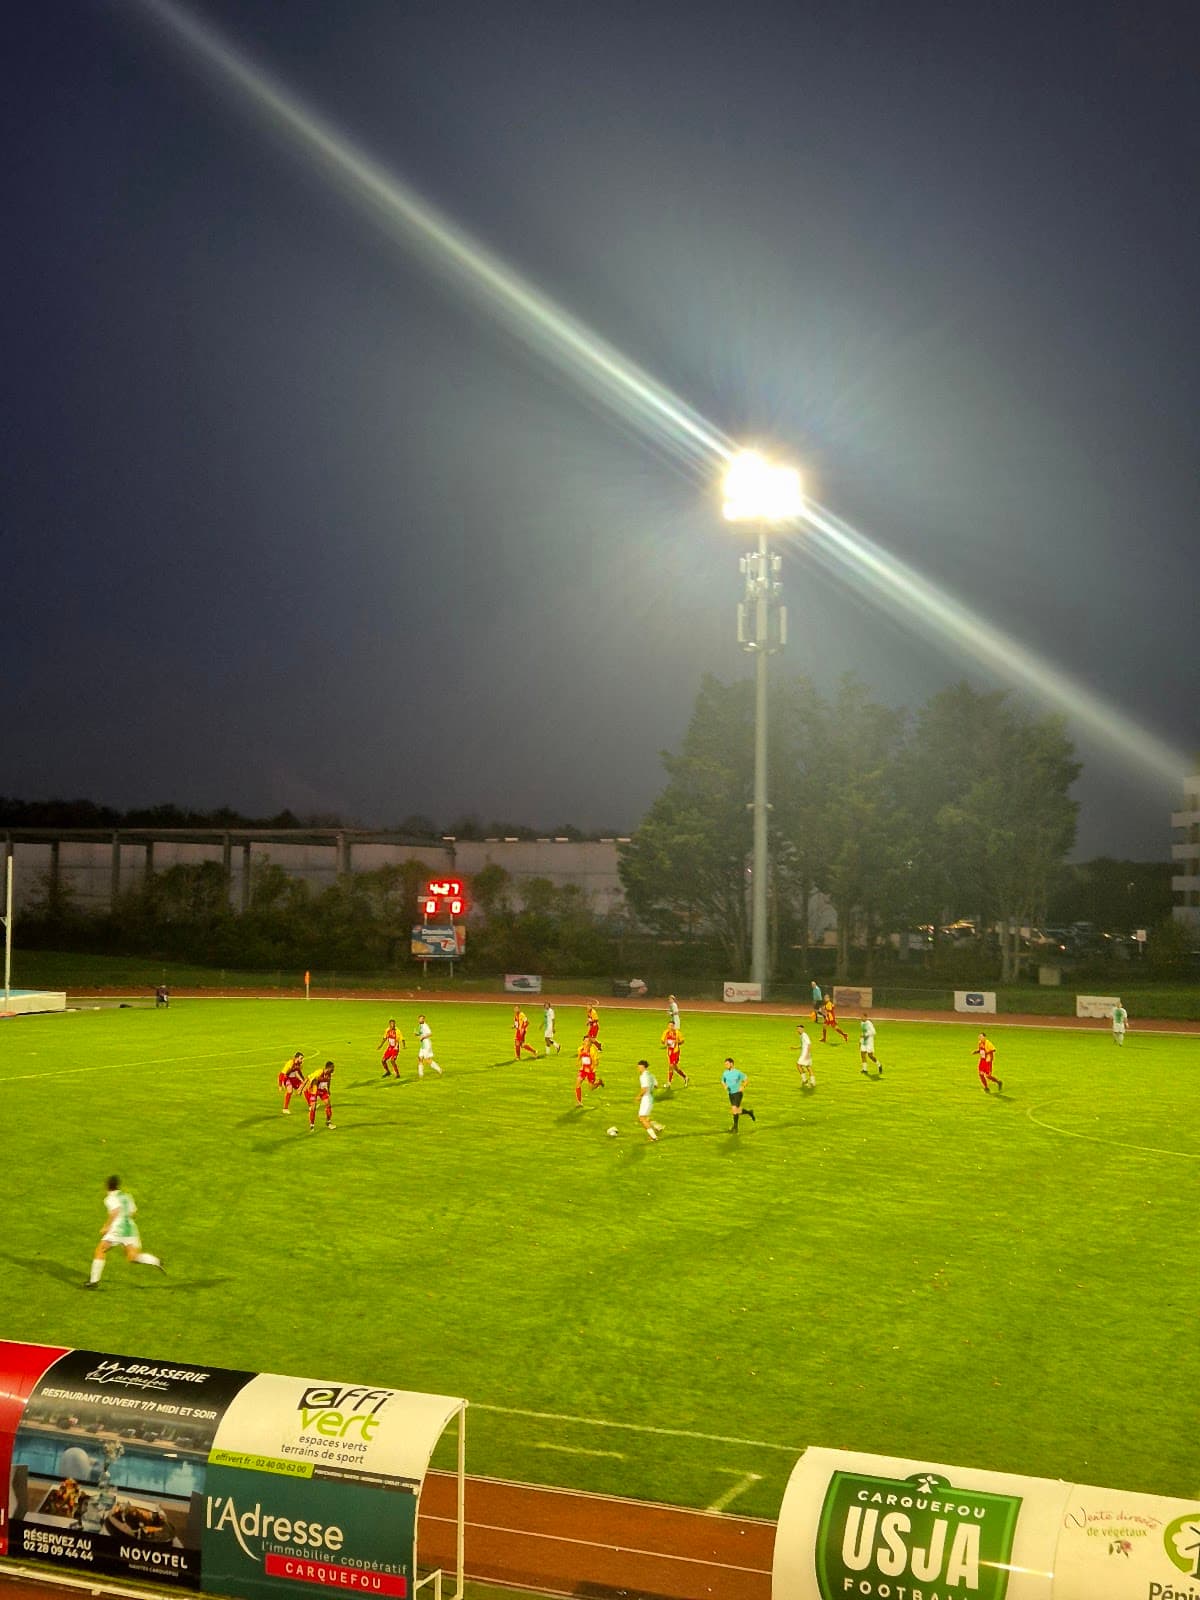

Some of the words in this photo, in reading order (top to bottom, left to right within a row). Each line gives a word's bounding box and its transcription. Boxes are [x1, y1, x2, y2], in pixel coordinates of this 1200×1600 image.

[451, 901, 462, 914] 0
[97, 1361, 120, 1371] LA
[126, 1364, 210, 1383] BRASSERIE
[41, 1387, 101, 1403] RESTAURANT
[101, 1396, 141, 1409] OUVERT
[141, 1400, 157, 1411] 7/7
[156, 1404, 180, 1415] MIDI
[179, 1407, 194, 1417] ET
[192, 1409, 217, 1420] SOIR
[305, 1388, 394, 1414] effi
[301, 1407, 380, 1441] vert
[280, 1444, 319, 1458] terrains
[320, 1450, 335, 1460] de
[336, 1453, 365, 1465] sport
[298, 1435, 341, 1448] espaces
[342, 1441, 369, 1452] verts
[255, 1460, 265, 1468] 02
[286, 1464, 296, 1472] 62
[296, 1465, 307, 1474] 00
[857, 1490, 986, 1519] CARQUEFOU
[23, 1528, 75, 1548] RÉSERVEZ
[76, 1538, 92, 1550] AU
[1086, 1527, 1099, 1536] de
[1102, 1526, 1147, 1537] végétaux
[23, 1540, 36, 1552] 02
[36, 1542, 49, 1554] 28
[50, 1544, 64, 1556] 09
[64, 1547, 79, 1559] 44
[79, 1550, 94, 1562] 44
[120, 1545, 188, 1569] NOVOTEL
[262, 1541, 336, 1563] l'immobilier
[340, 1556, 408, 1575] coopératif
[841, 1505, 981, 1590] USJA
[285, 1562, 381, 1589] CARQUEFOU
[843, 1577, 968, 1600] FOOTBA
